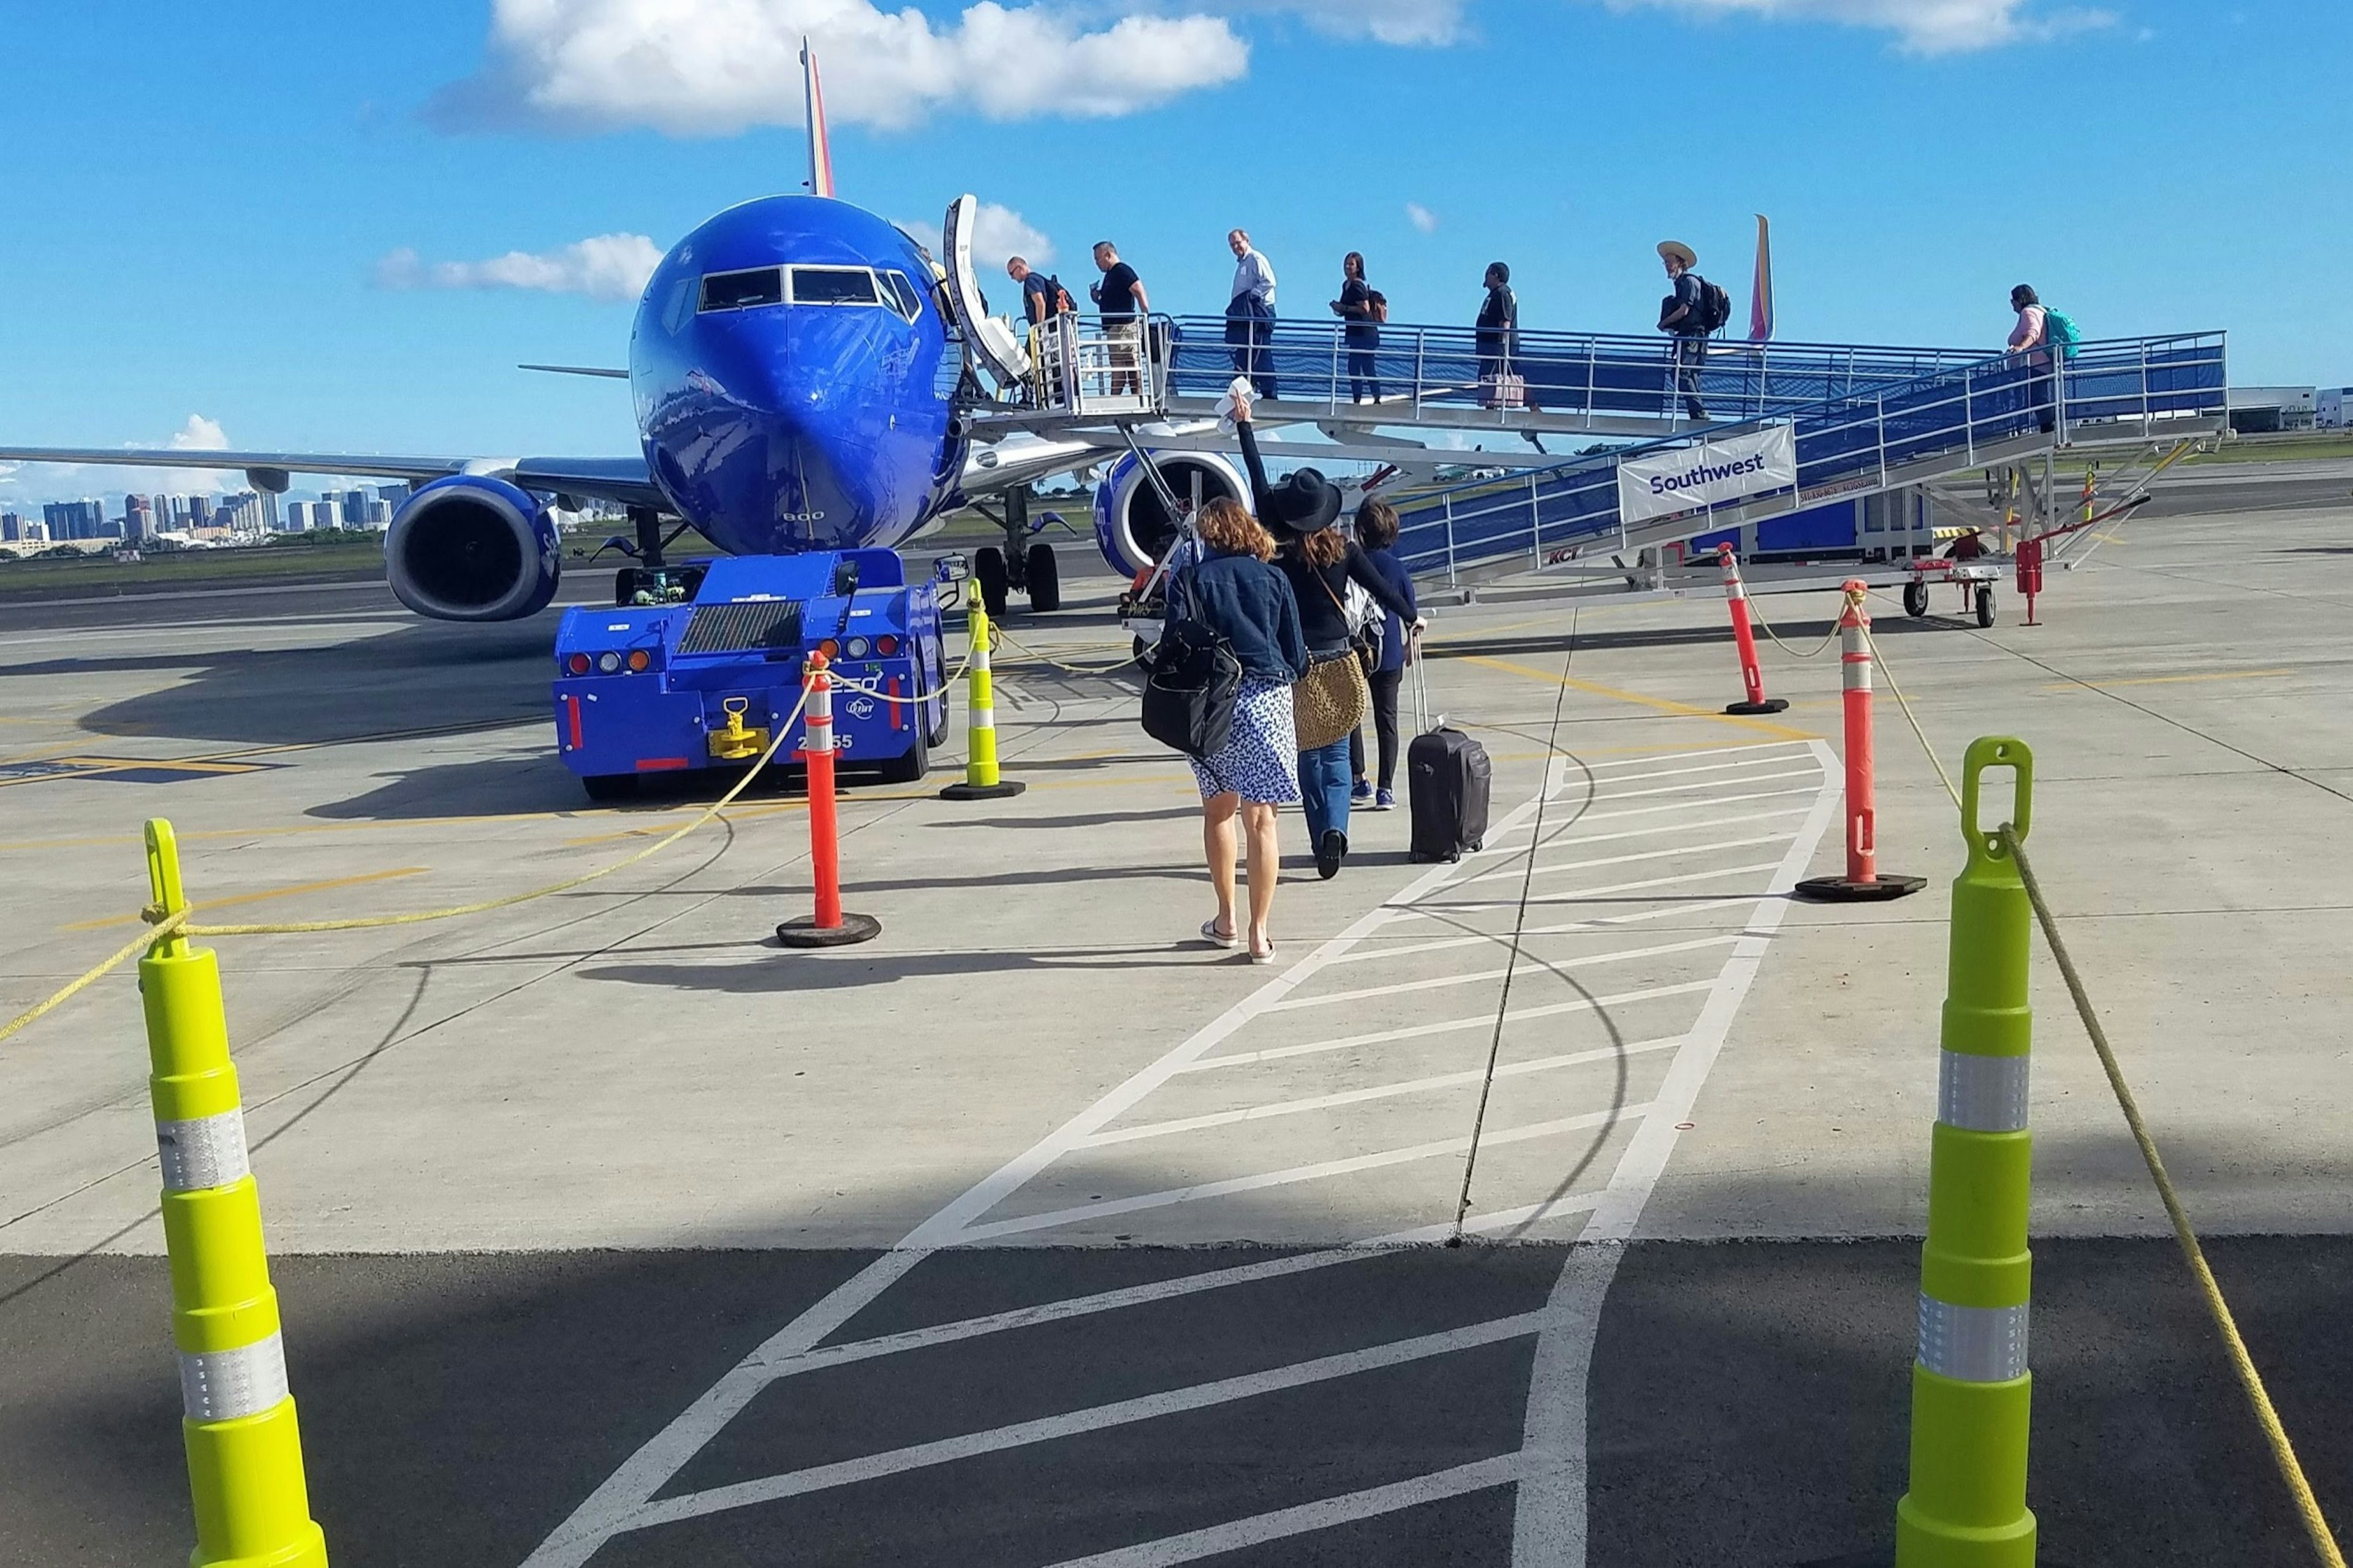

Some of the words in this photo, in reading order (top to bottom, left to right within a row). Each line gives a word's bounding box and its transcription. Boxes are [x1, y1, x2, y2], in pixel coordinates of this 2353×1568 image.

[1650, 453, 1765, 494] Southwest
[782, 511, 825, 521] 800
[1548, 547, 1579, 565] KCI
